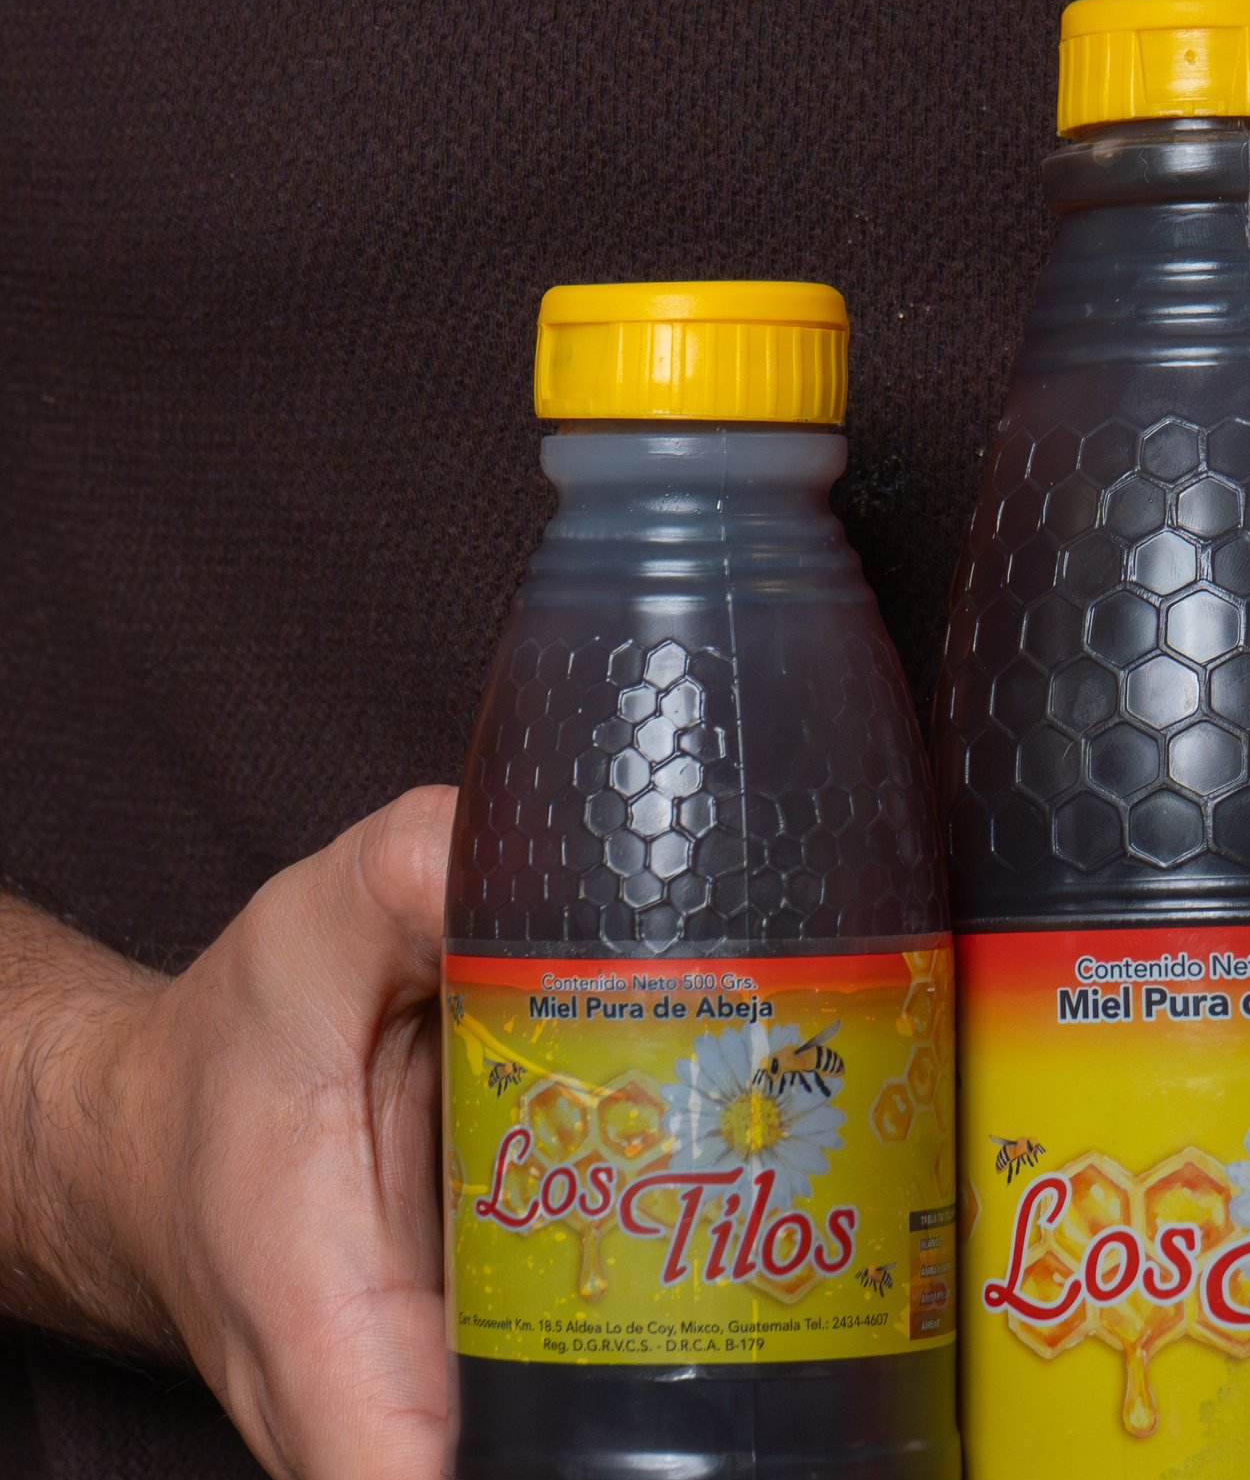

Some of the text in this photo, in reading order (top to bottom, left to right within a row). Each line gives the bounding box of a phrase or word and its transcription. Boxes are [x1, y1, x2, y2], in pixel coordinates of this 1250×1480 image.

[1077, 953, 1203, 981] Contenido
[541, 973, 758, 991] Contenido Neto 500 Grs.
[529, 995, 773, 1023] Miel Pura de Abeja
[1058, 985, 1131, 1021] Miel
[1144, 985, 1230, 1019] Pura
[475, 1127, 857, 1286] Los Tilos
[983, 1173, 1200, 1327] Los
[514, 1318, 535, 1332] Km.
[539, 1320, 563, 1333] 18.5
[566, 1320, 601, 1334] Aldea
[606, 1321, 622, 1334] Lo
[626, 1321, 643, 1334] de
[647, 1321, 677, 1337] Coy,
[680, 1320, 723, 1335] Mixco,
[728, 1317, 800, 1334] Guatemala
[832, 1313, 889, 1330] 2434-4607
[543, 1339, 569, 1354] Reg.
[573, 1339, 653, 1353] D.G.R.V.C.S.
[666, 1338, 720, 1352] D.R.C.A.
[725, 1337, 765, 1351] B-179
